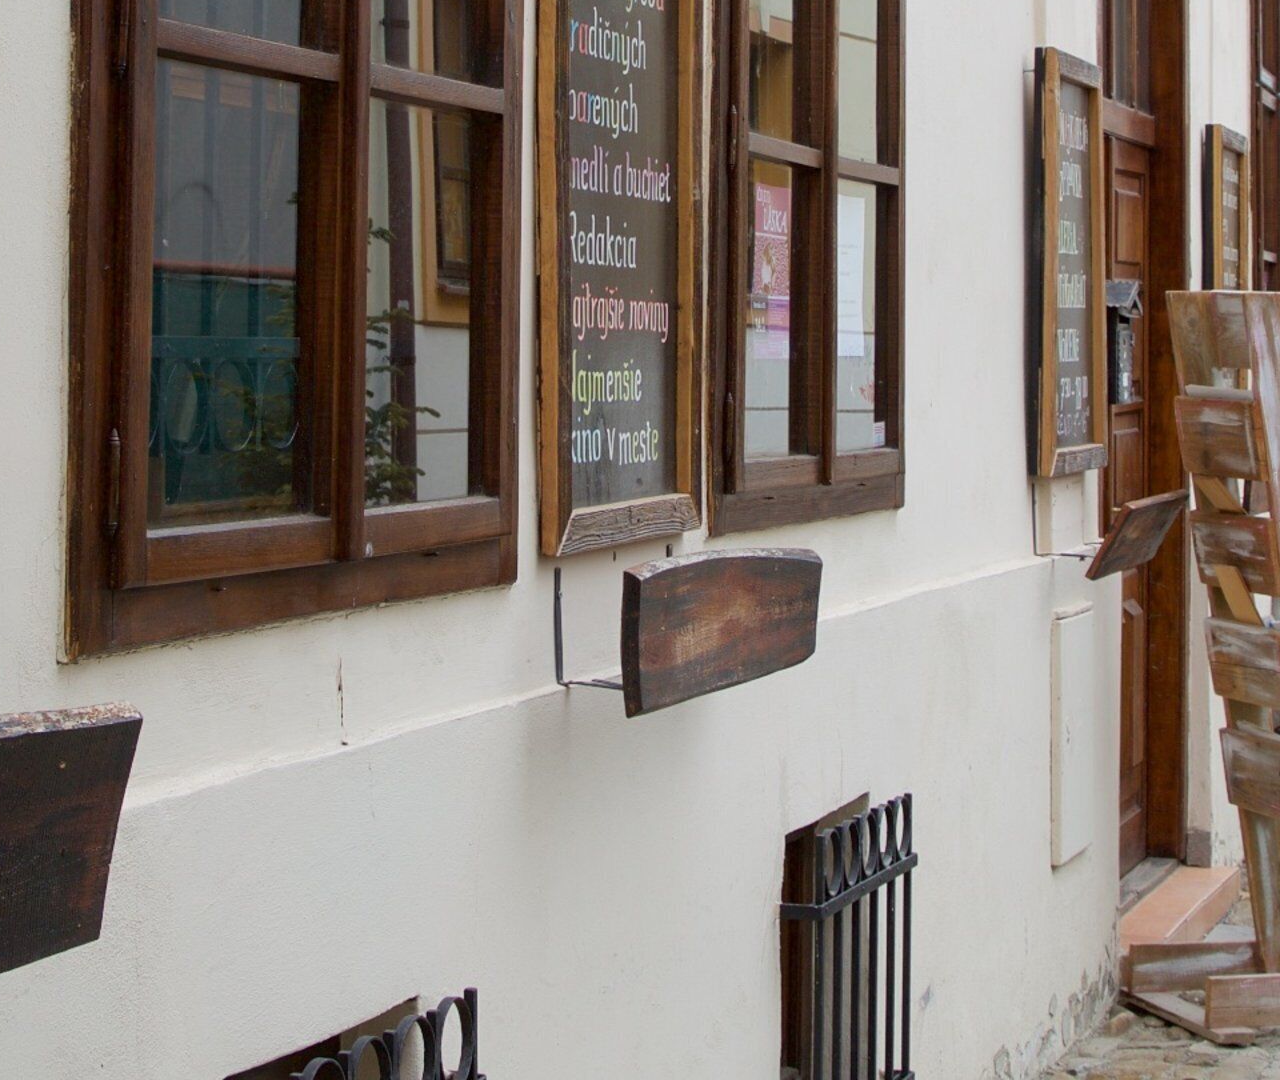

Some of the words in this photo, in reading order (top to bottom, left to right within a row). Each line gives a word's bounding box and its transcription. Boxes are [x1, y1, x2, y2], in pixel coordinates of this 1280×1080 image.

[614, 164, 623, 195] a
[626, 151, 671, 204] buchiet
[629, 289, 669, 344] noviny
[619, 420, 659, 466] meste
